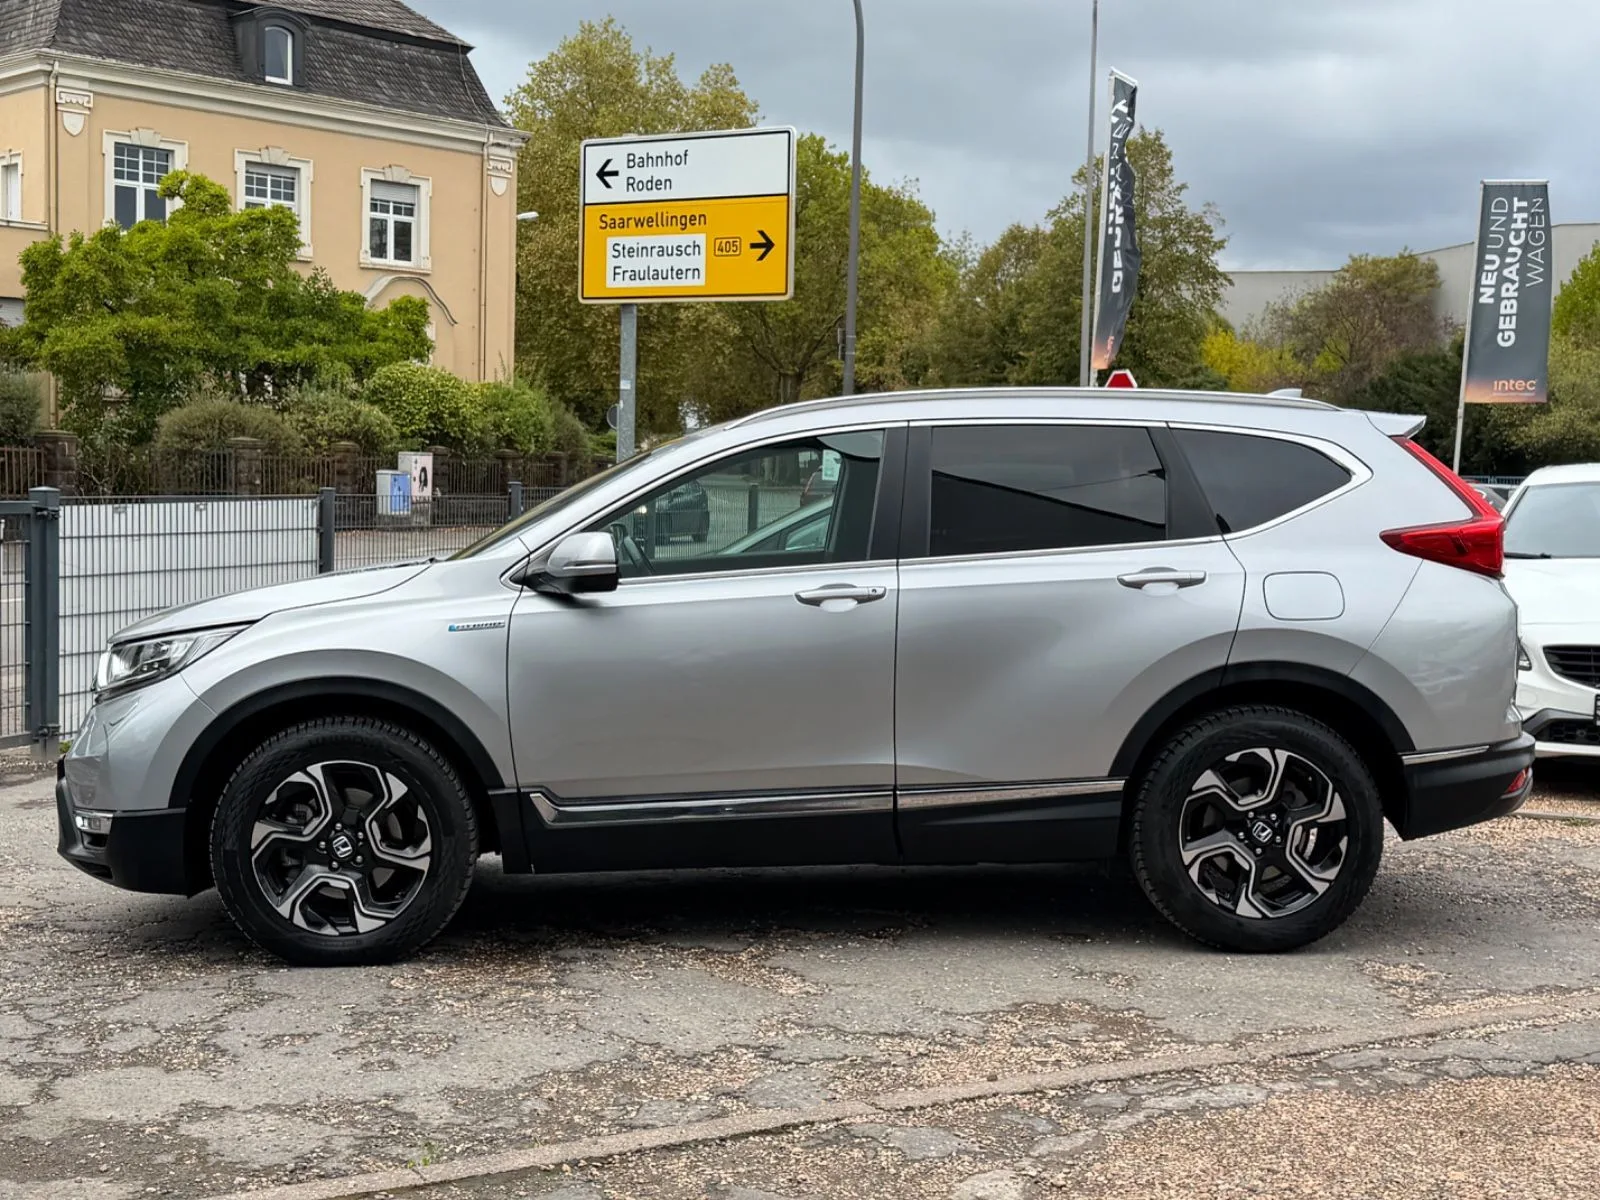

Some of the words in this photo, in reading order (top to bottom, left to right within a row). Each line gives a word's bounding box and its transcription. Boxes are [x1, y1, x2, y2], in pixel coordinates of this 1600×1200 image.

[626, 150, 689, 169] Bahnhof
[626, 176, 672, 193] Roden
[599, 211, 707, 232] Saarwellingen
[1486, 197, 1509, 249] UND
[612, 240, 701, 259] Steinrausch
[717, 240, 739, 254] 405
[1525, 197, 1546, 288] WAGEN
[612, 265, 701, 282] Fraulautern
[1478, 254, 1501, 304] NEU
[1496, 197, 1528, 348] GEBRAUCHT
[1493, 379, 1536, 391] intec
